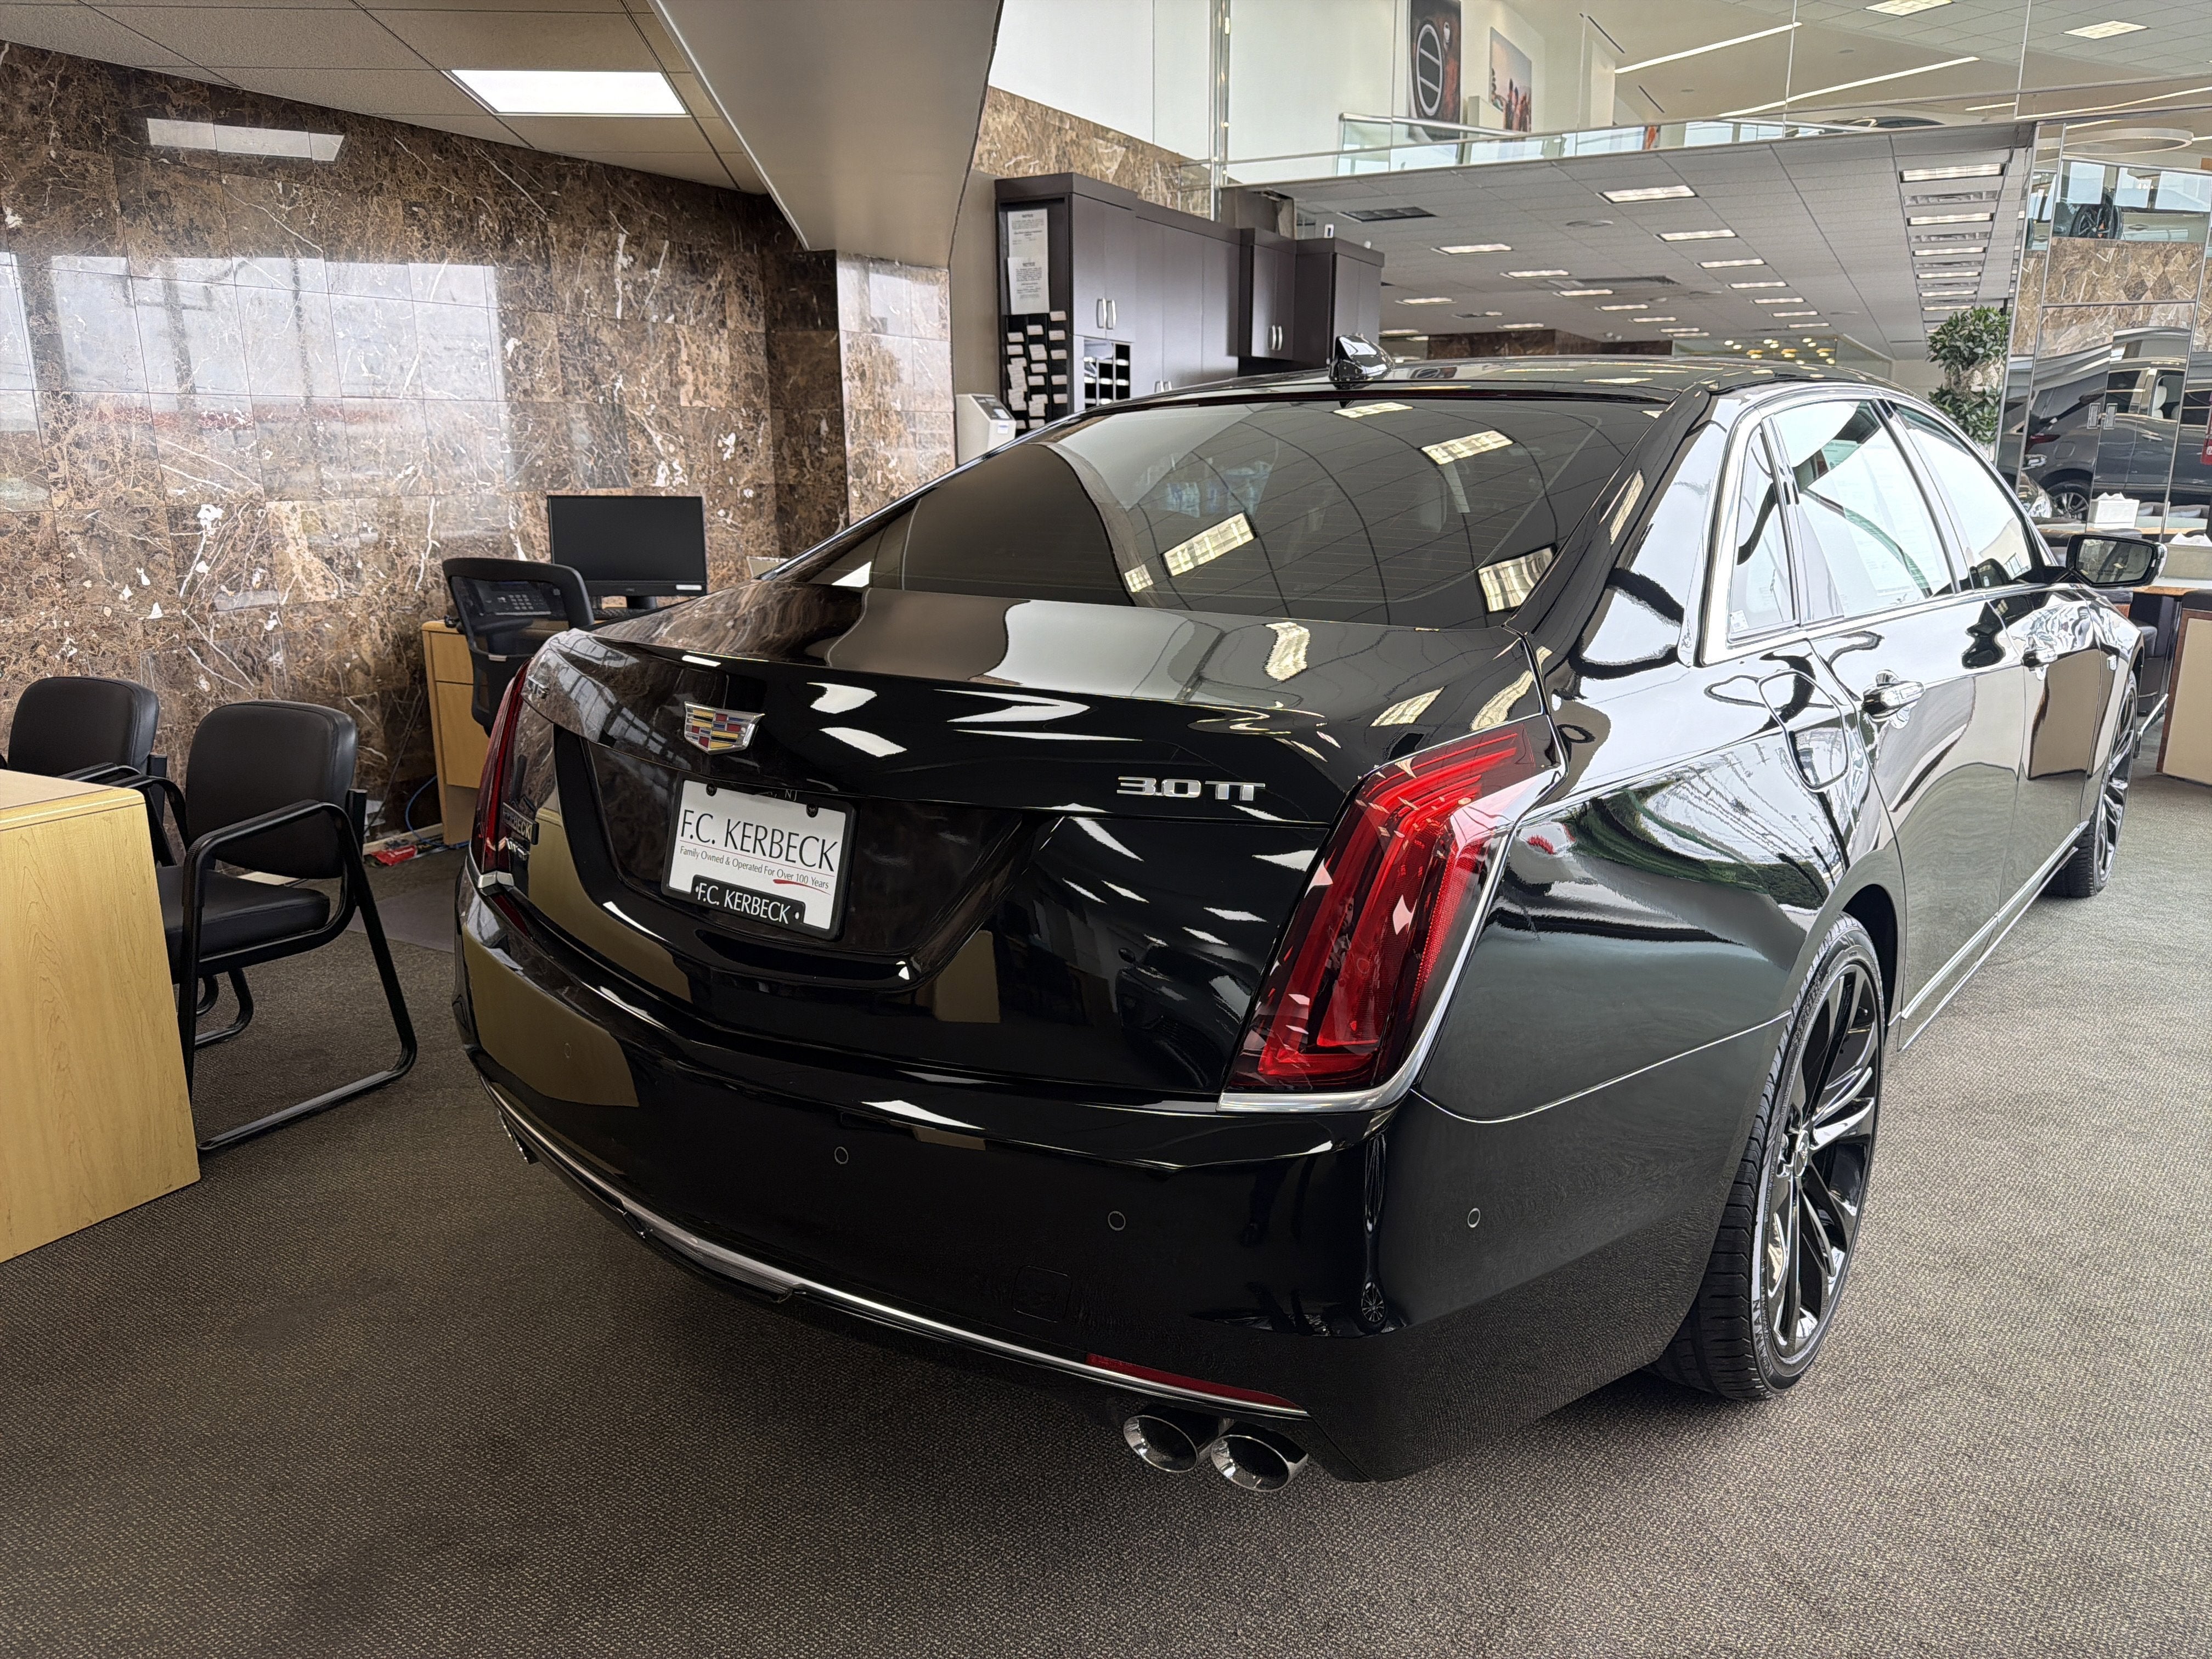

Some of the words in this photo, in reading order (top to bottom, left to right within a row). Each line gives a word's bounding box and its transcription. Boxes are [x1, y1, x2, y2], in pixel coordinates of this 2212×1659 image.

[680, 809, 716, 845] F.C.
[724, 818, 838, 872] KERBECK
[680, 846, 700, 860] Family
[701, 851, 724, 864] Owned
[725, 856, 731, 866] &
[732, 859, 763, 873] Operated
[764, 866, 775, 877] For
[776, 869, 794, 881] Over
[795, 873, 809, 884] 100
[810, 876, 829, 889] Years
[697, 882, 719, 906] F.C.
[724, 890, 791, 924] KERBECK
